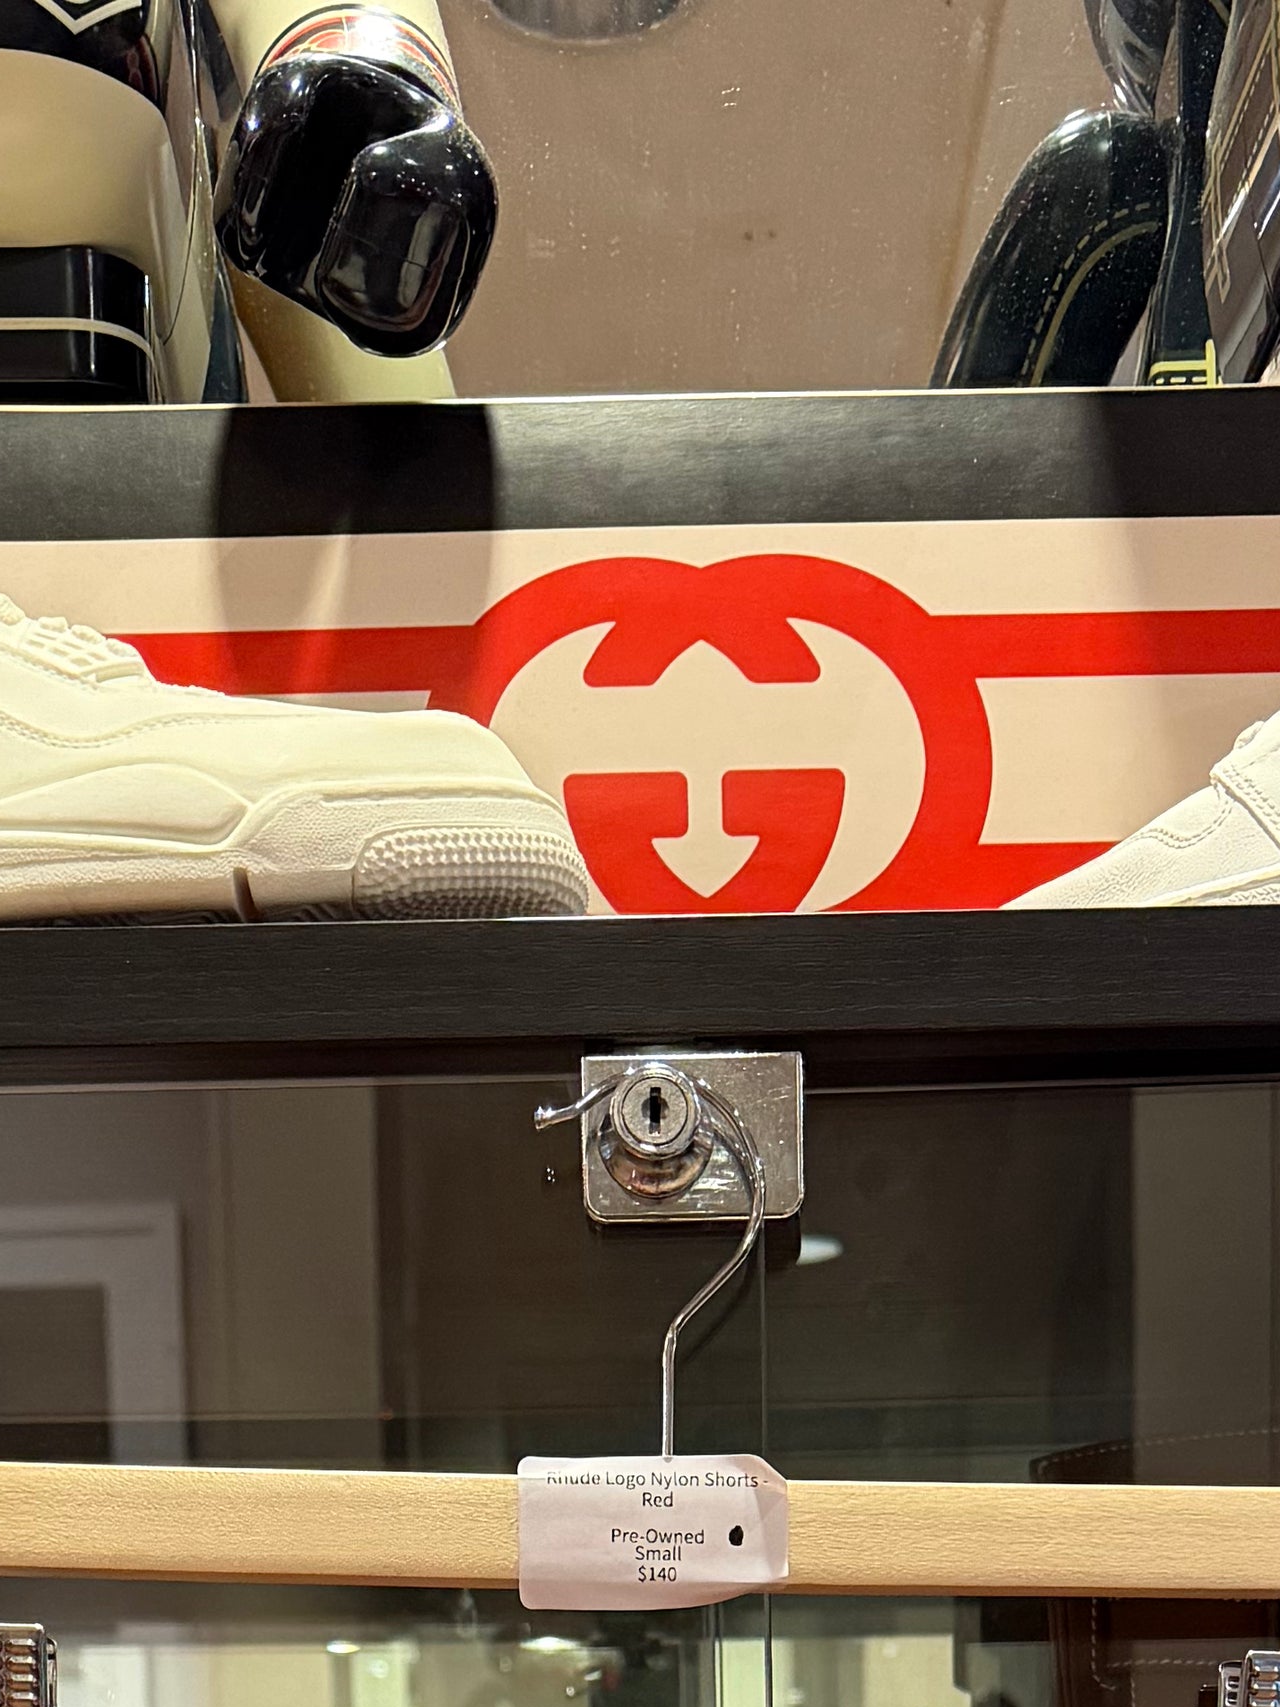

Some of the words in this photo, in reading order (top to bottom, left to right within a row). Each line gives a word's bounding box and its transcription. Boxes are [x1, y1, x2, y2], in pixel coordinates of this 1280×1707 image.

[605, 1471, 646, 1490] Logo
[651, 1471, 699, 1490] Nylon
[704, 1471, 759, 1487] Shorts
[642, 1491, 674, 1508] Red
[610, 1528, 705, 1545] Pre-Owned
[634, 1546, 683, 1562] Small
[637, 1565, 678, 1583] $140
